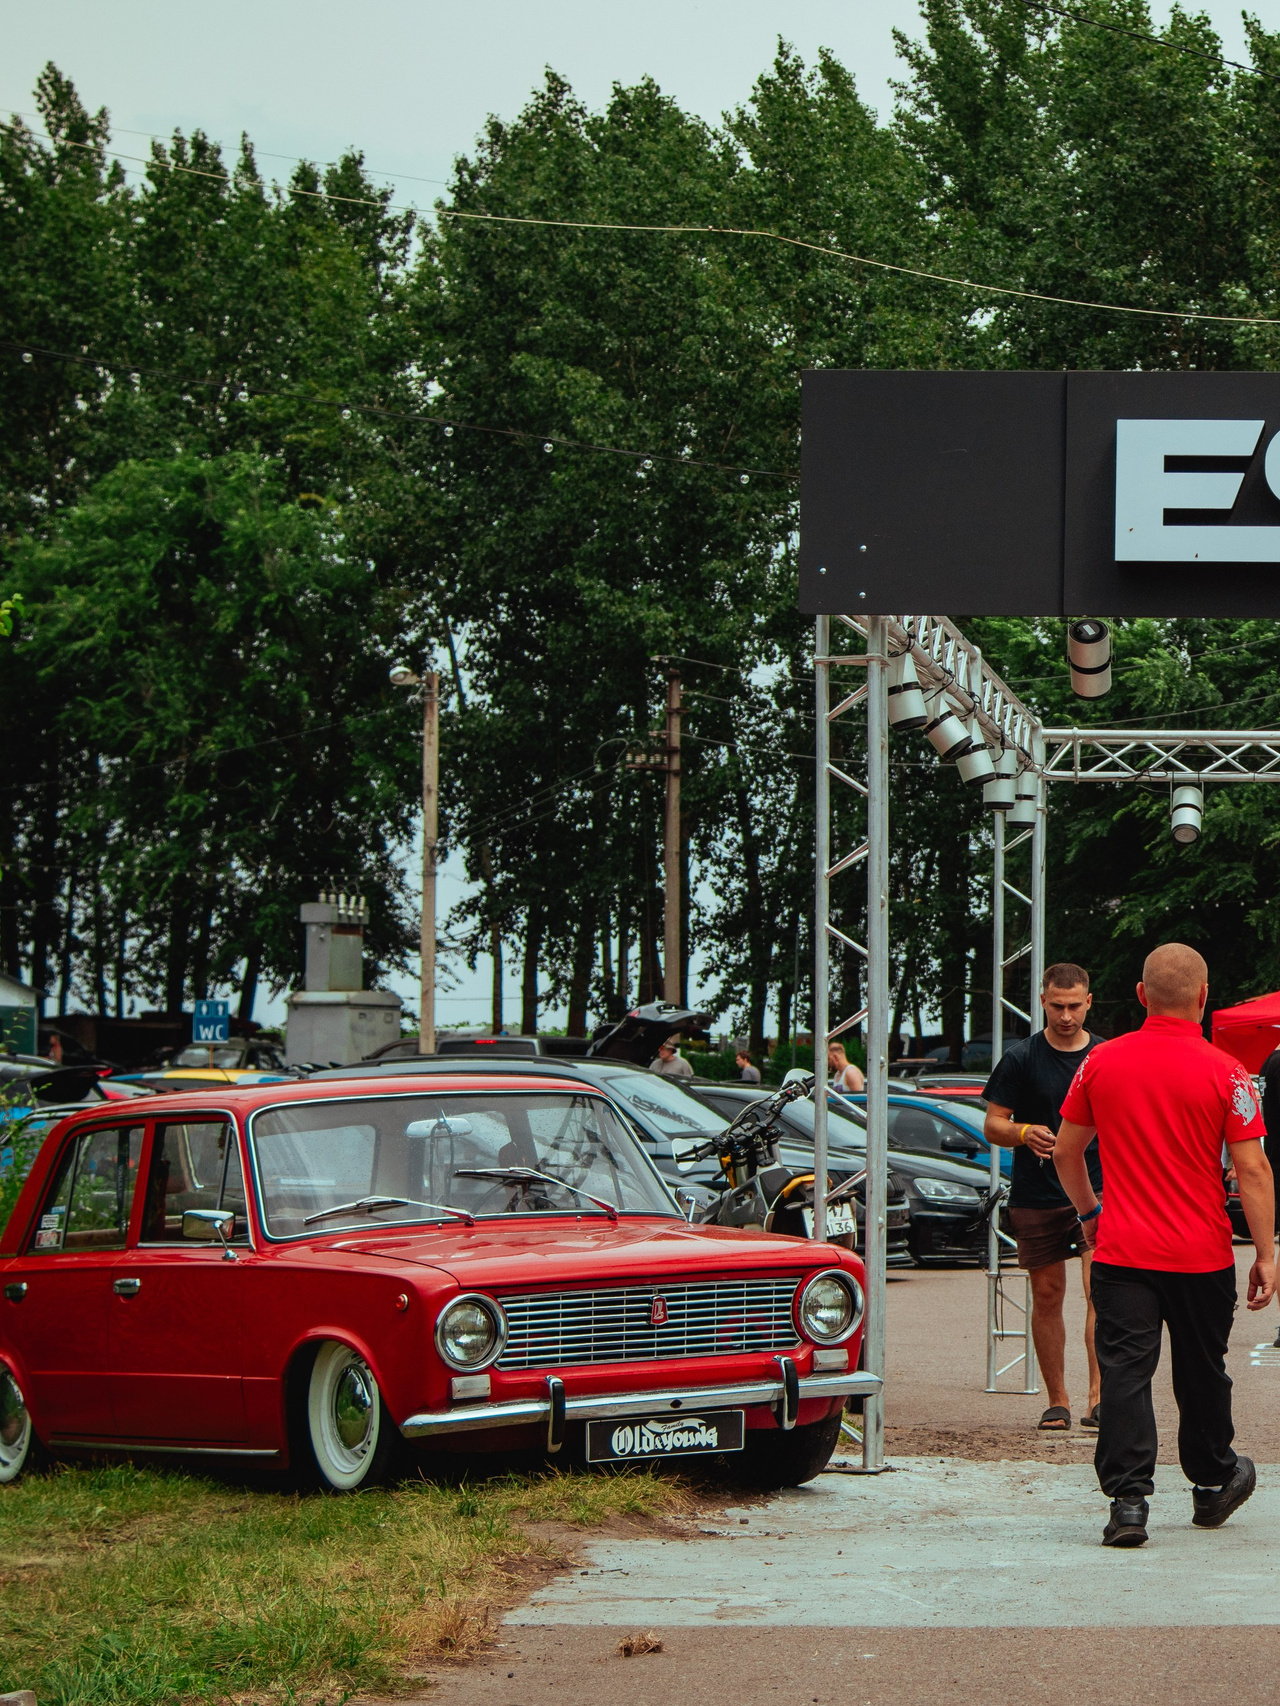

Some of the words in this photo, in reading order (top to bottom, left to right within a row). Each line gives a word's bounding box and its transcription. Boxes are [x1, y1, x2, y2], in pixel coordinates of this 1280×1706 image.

[199, 1024, 224, 1040] WC
[835, 1222, 852, 1233] 36
[661, 1421, 684, 1432] Family
